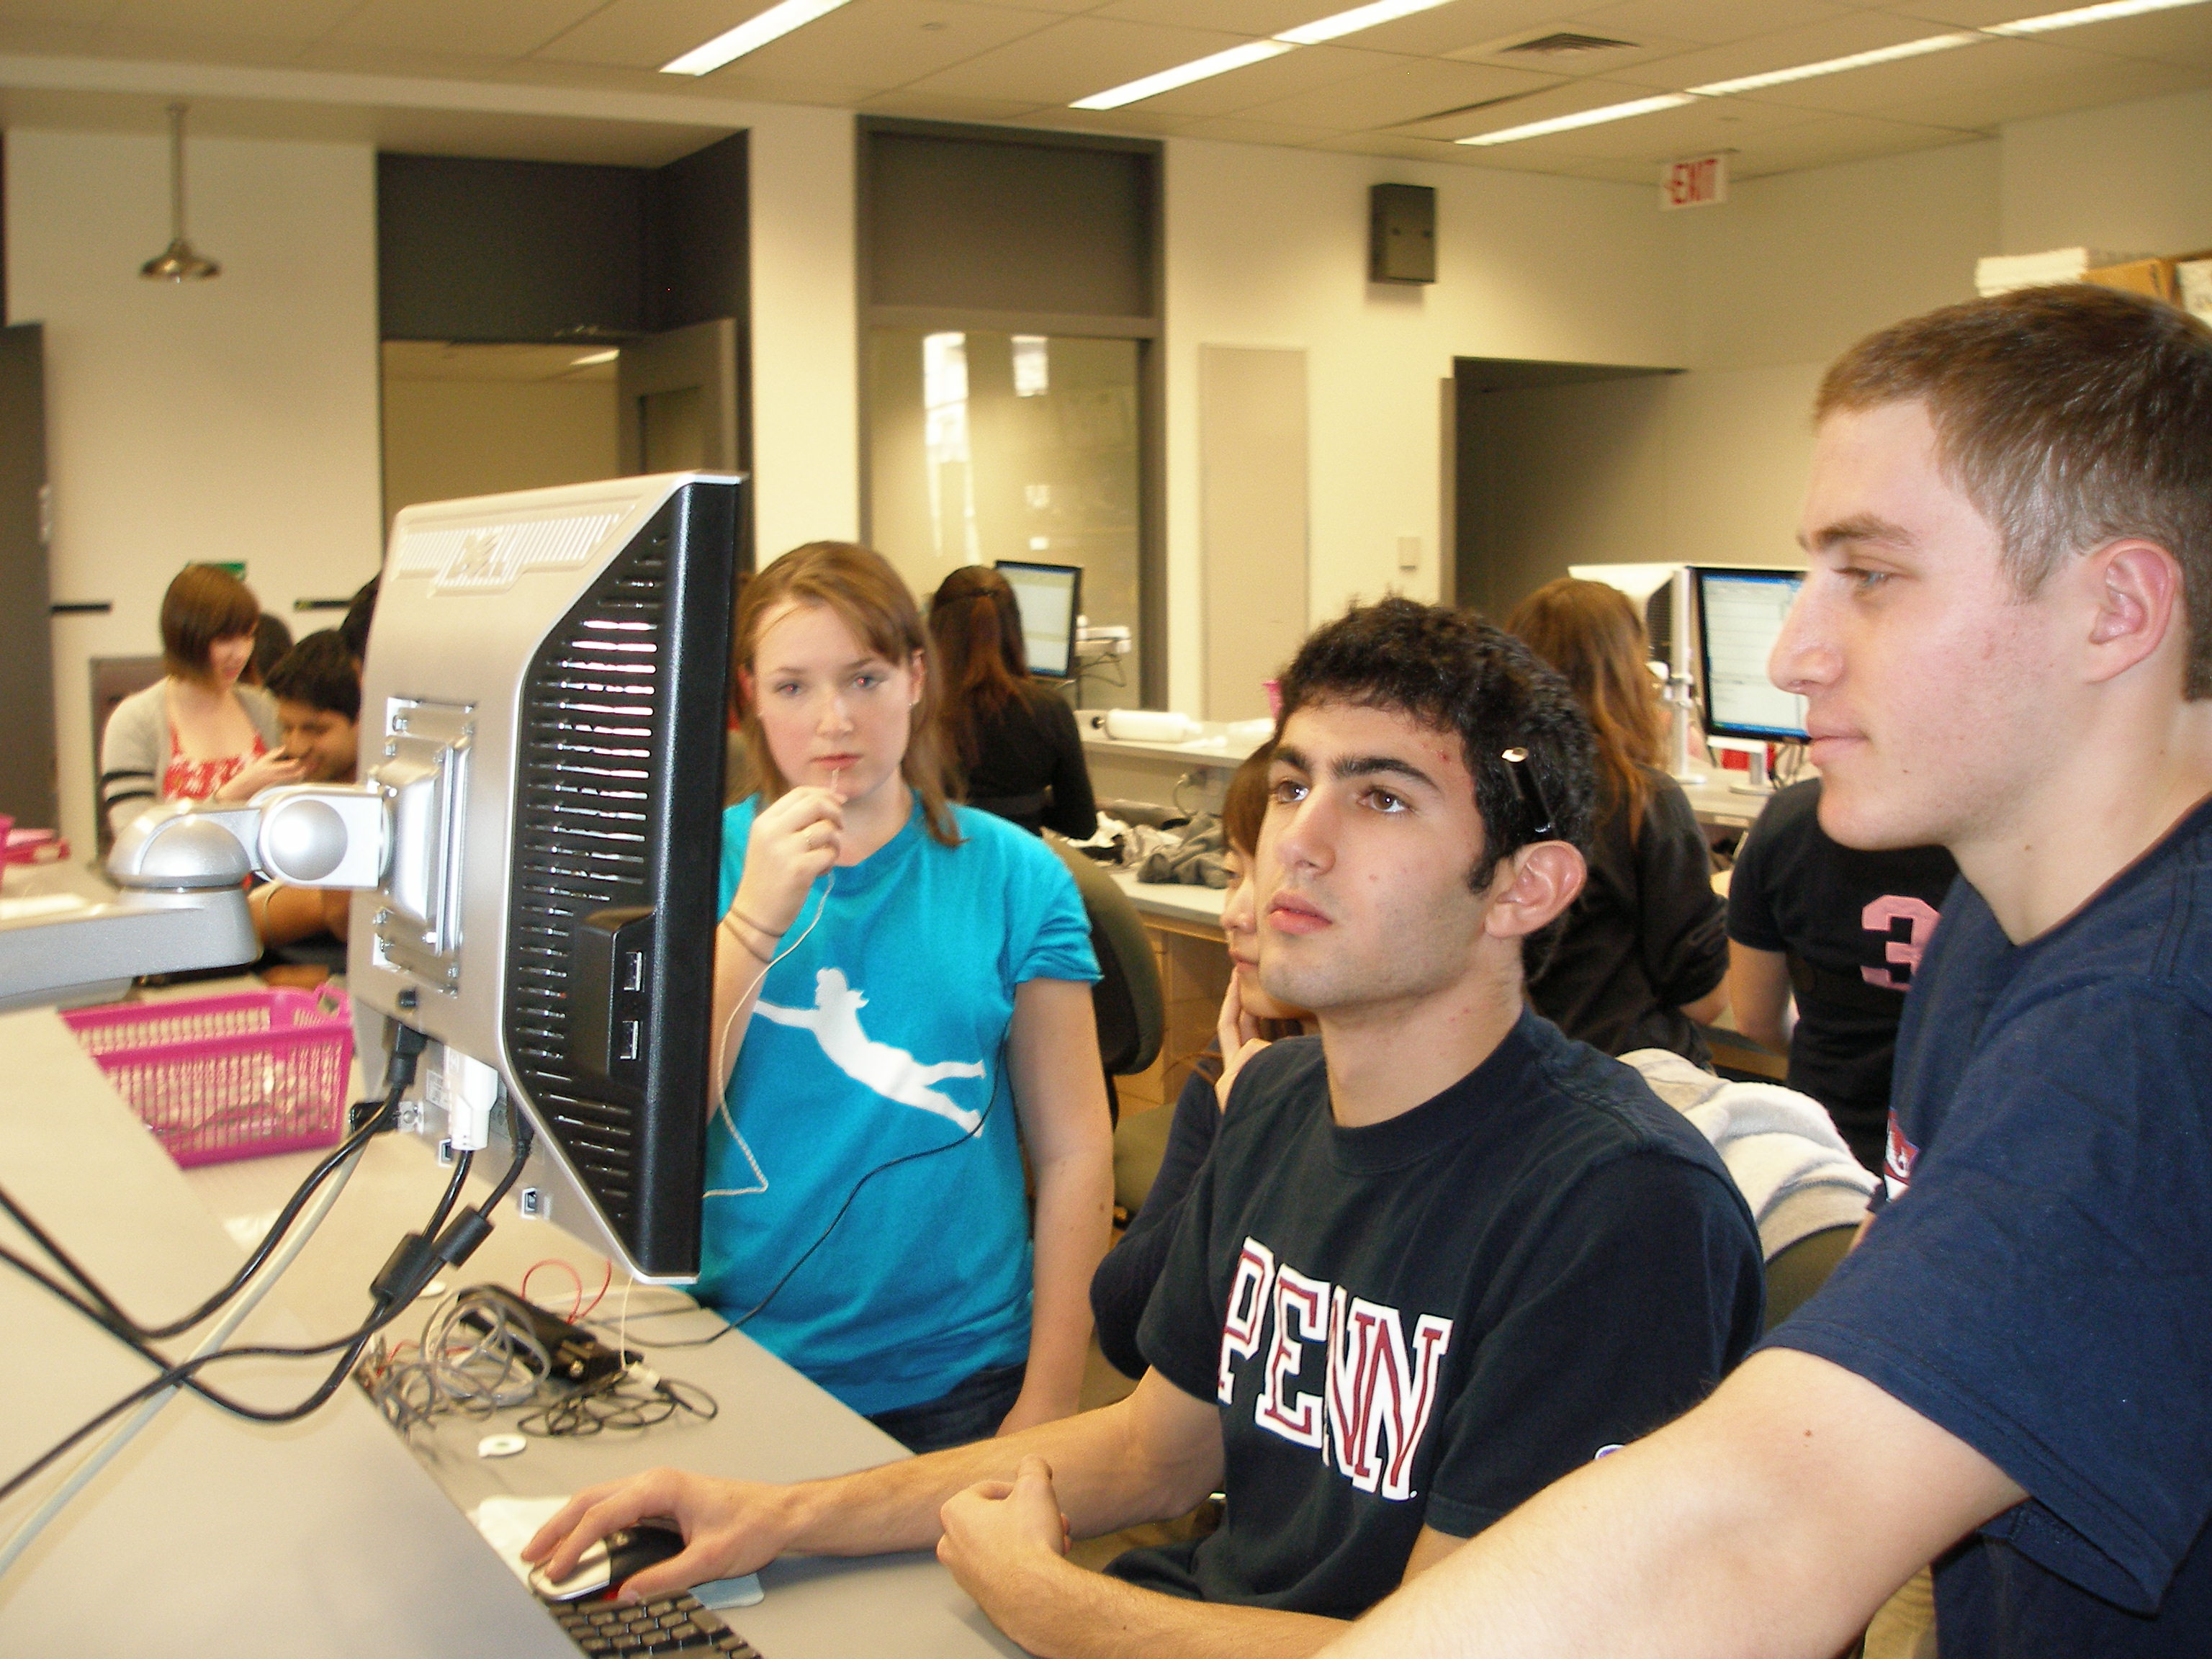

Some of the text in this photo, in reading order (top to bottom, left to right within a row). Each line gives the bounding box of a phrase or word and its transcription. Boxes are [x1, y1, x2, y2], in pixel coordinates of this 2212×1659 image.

[1671, 158, 1717, 204] EXIT
[1860, 894, 1942, 992] 3
[1218, 1235, 1454, 1502] PENN
